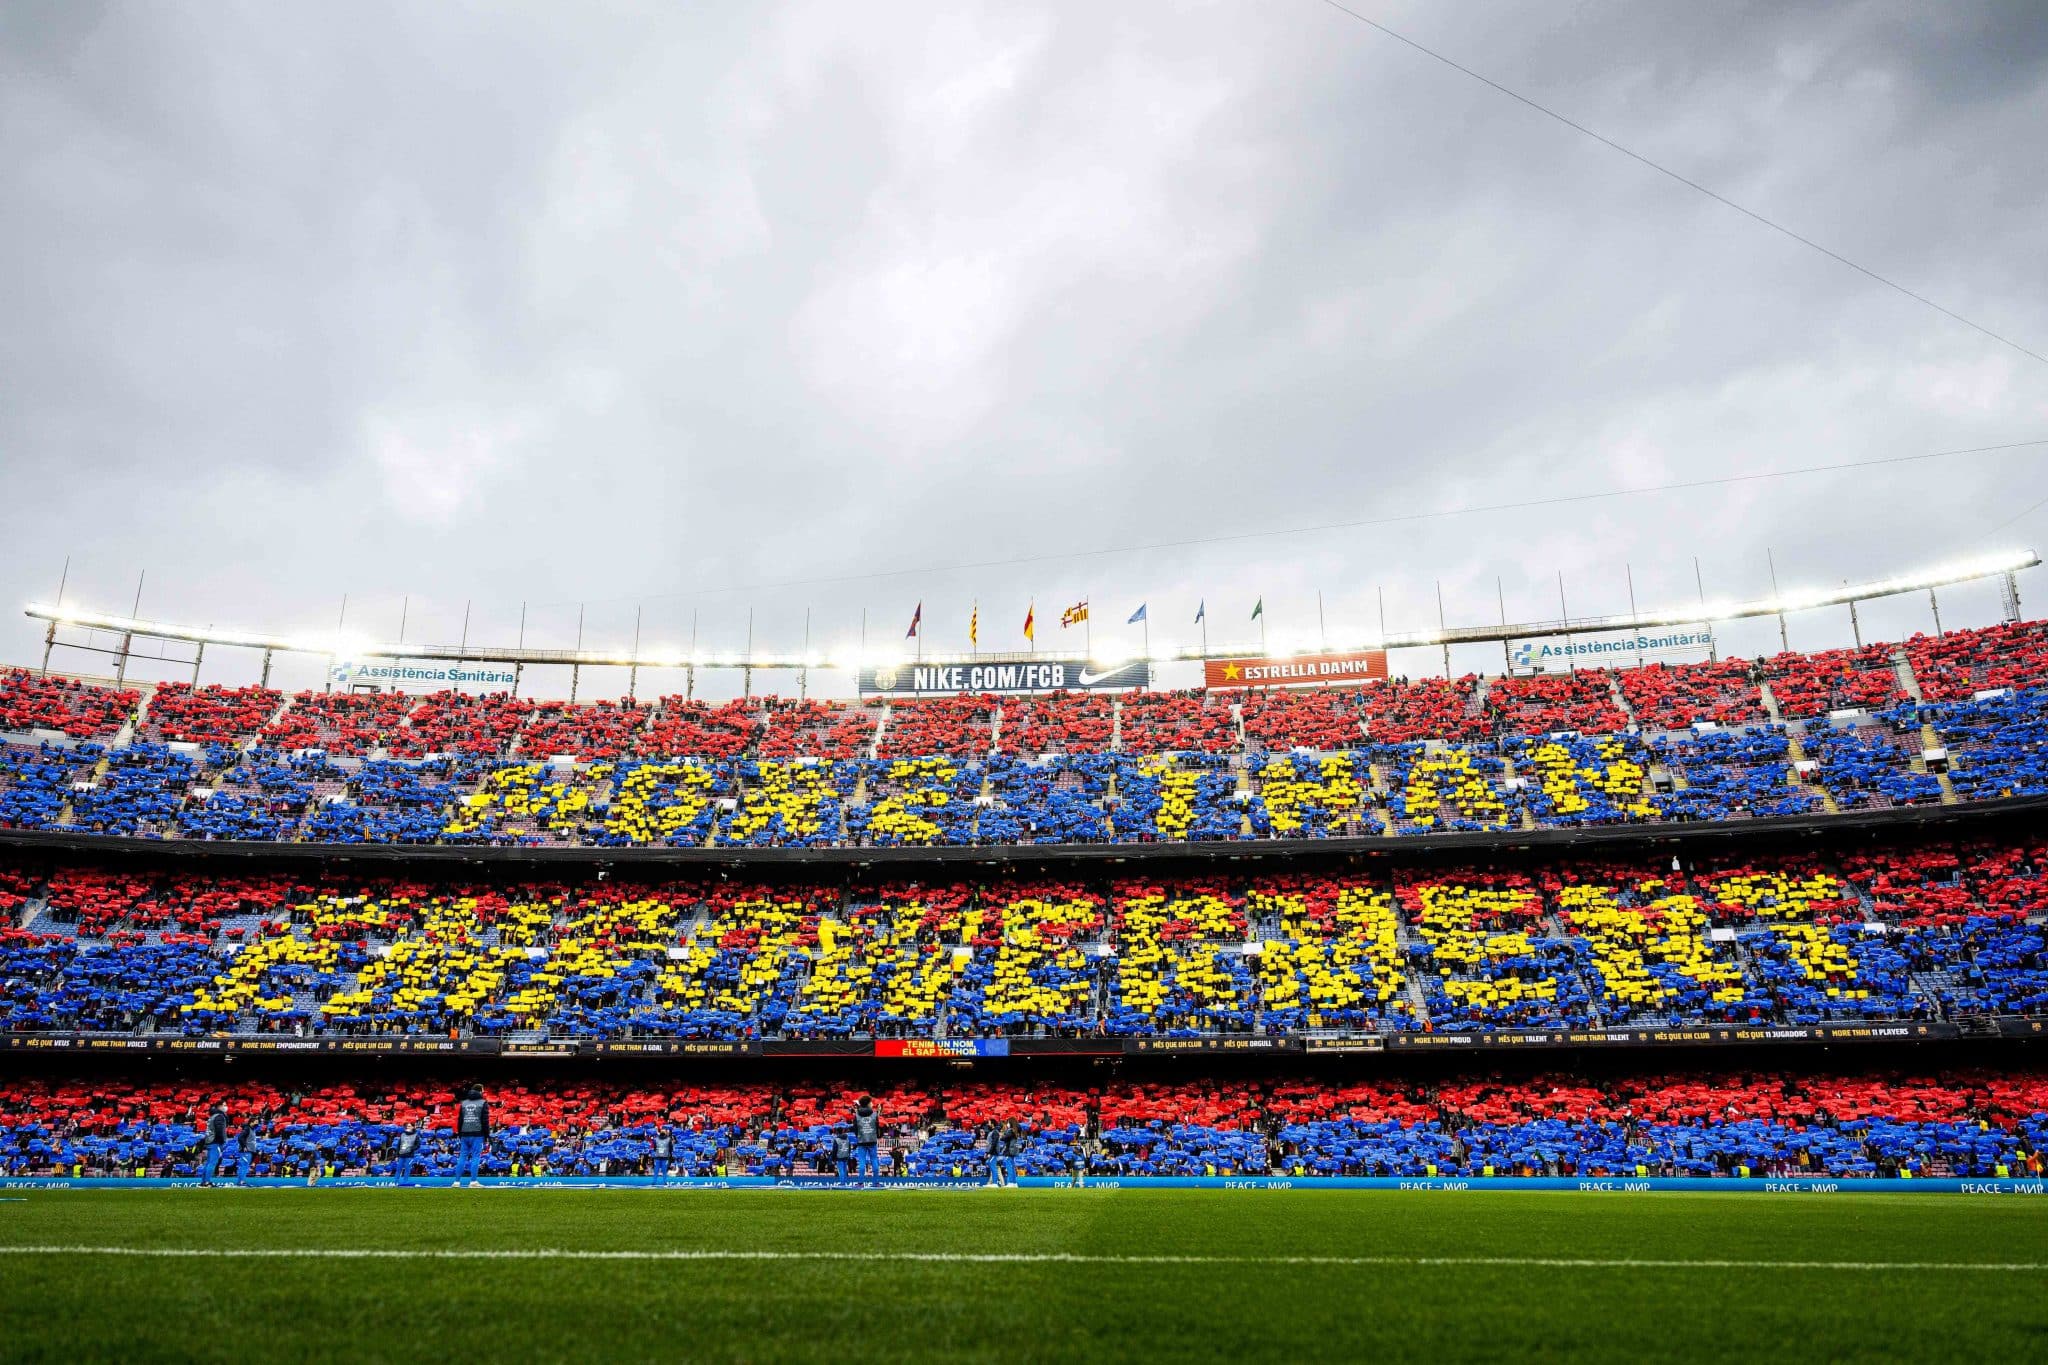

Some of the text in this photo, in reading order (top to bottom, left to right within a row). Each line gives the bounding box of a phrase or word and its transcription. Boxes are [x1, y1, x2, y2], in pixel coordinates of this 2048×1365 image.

[1540, 633, 1711, 657] Assistència Sanitària
[358, 664, 514, 683] Assistència Sanitària
[914, 664, 1065, 690] NIKE.COM/FCB
[1245, 660, 1368, 680] ESTRELLA DAMM
[1580, 1183, 1612, 1191] PEACE
[1766, 1184, 1799, 1192] PEACE
[1961, 1184, 2001, 1193] PEACE
